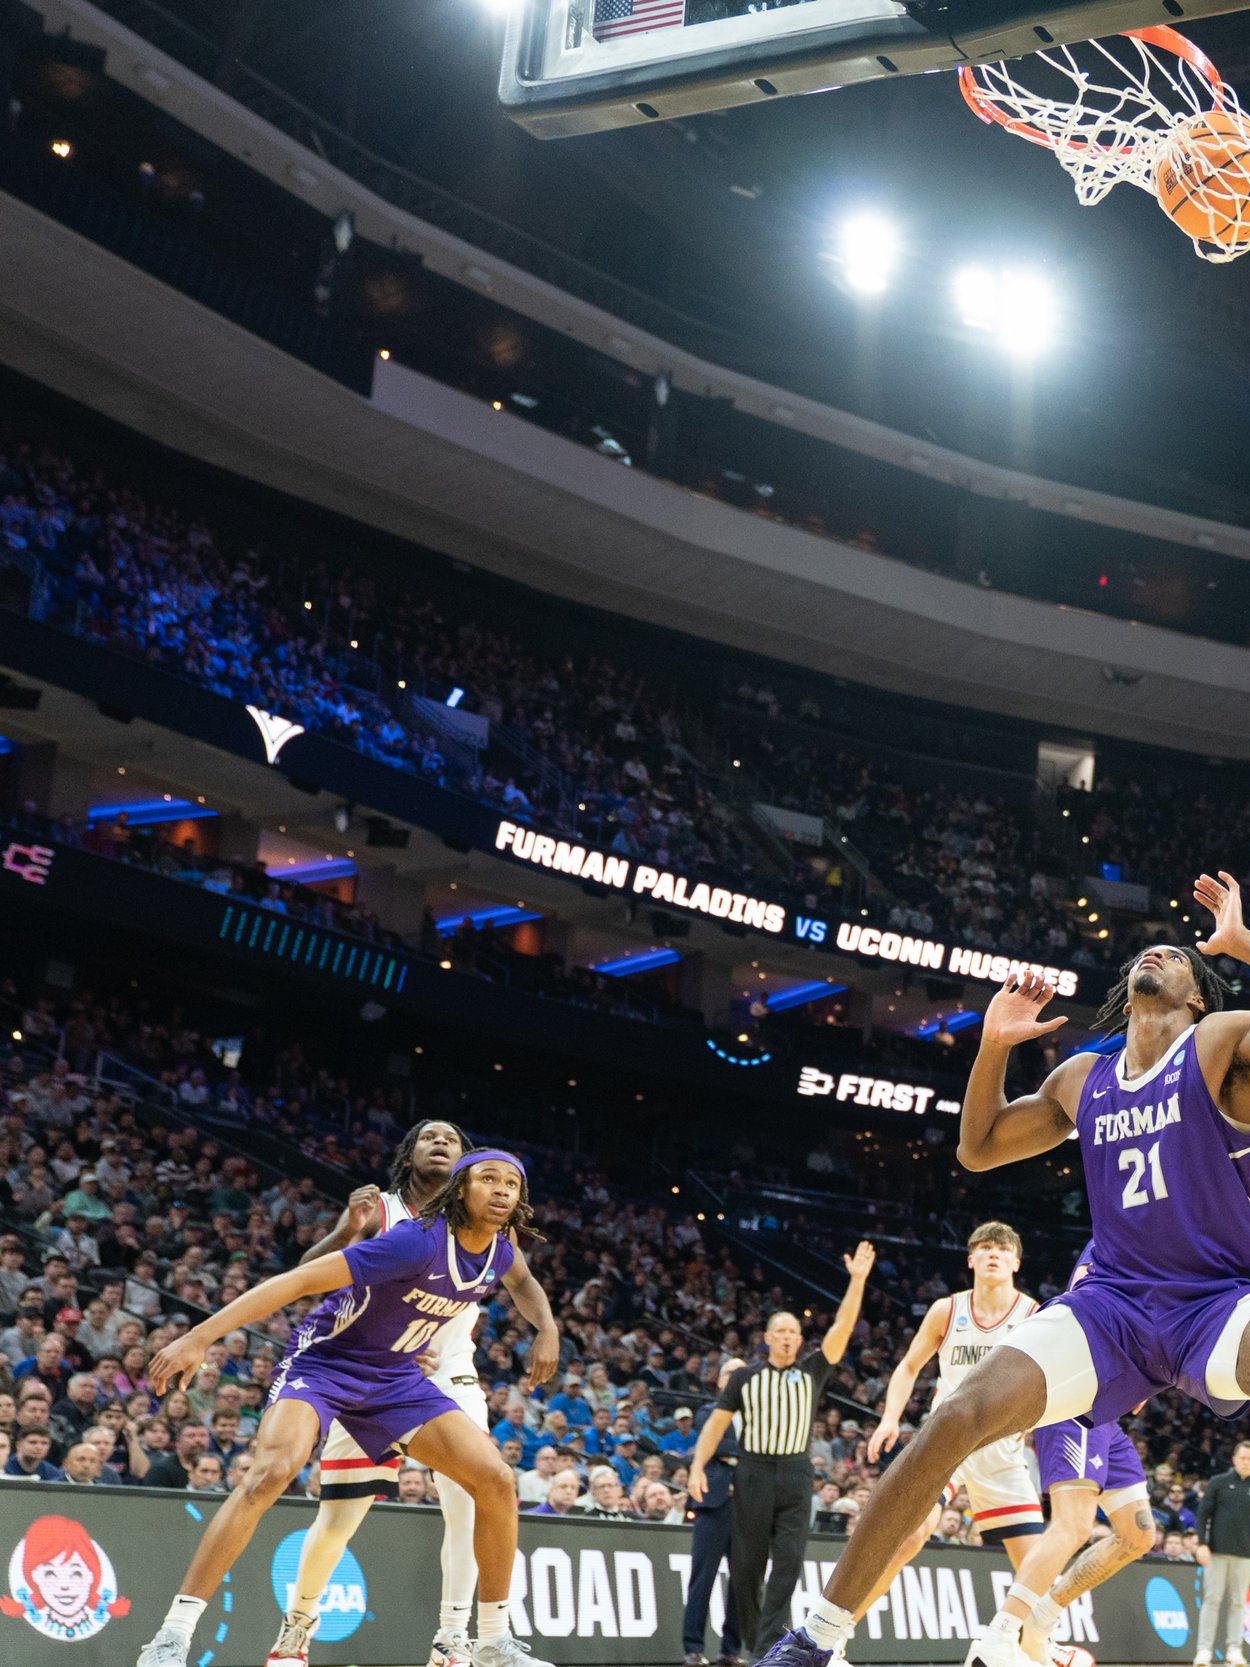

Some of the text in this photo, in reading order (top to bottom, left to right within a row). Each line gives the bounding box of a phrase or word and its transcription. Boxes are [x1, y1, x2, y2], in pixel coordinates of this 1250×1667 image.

[494, 820, 630, 889] FURMAN
[632, 864, 787, 933] PALADINS
[795, 916, 828, 943] VS
[836, 922, 945, 970] UCONN
[836, 1074, 935, 1114] FIRST
[1094, 1092, 1182, 1146] FURMAN
[1118, 1141, 1169, 1209] 21
[390, 1318, 440, 1354] 10
[507, 1547, 659, 1638] ROAD
